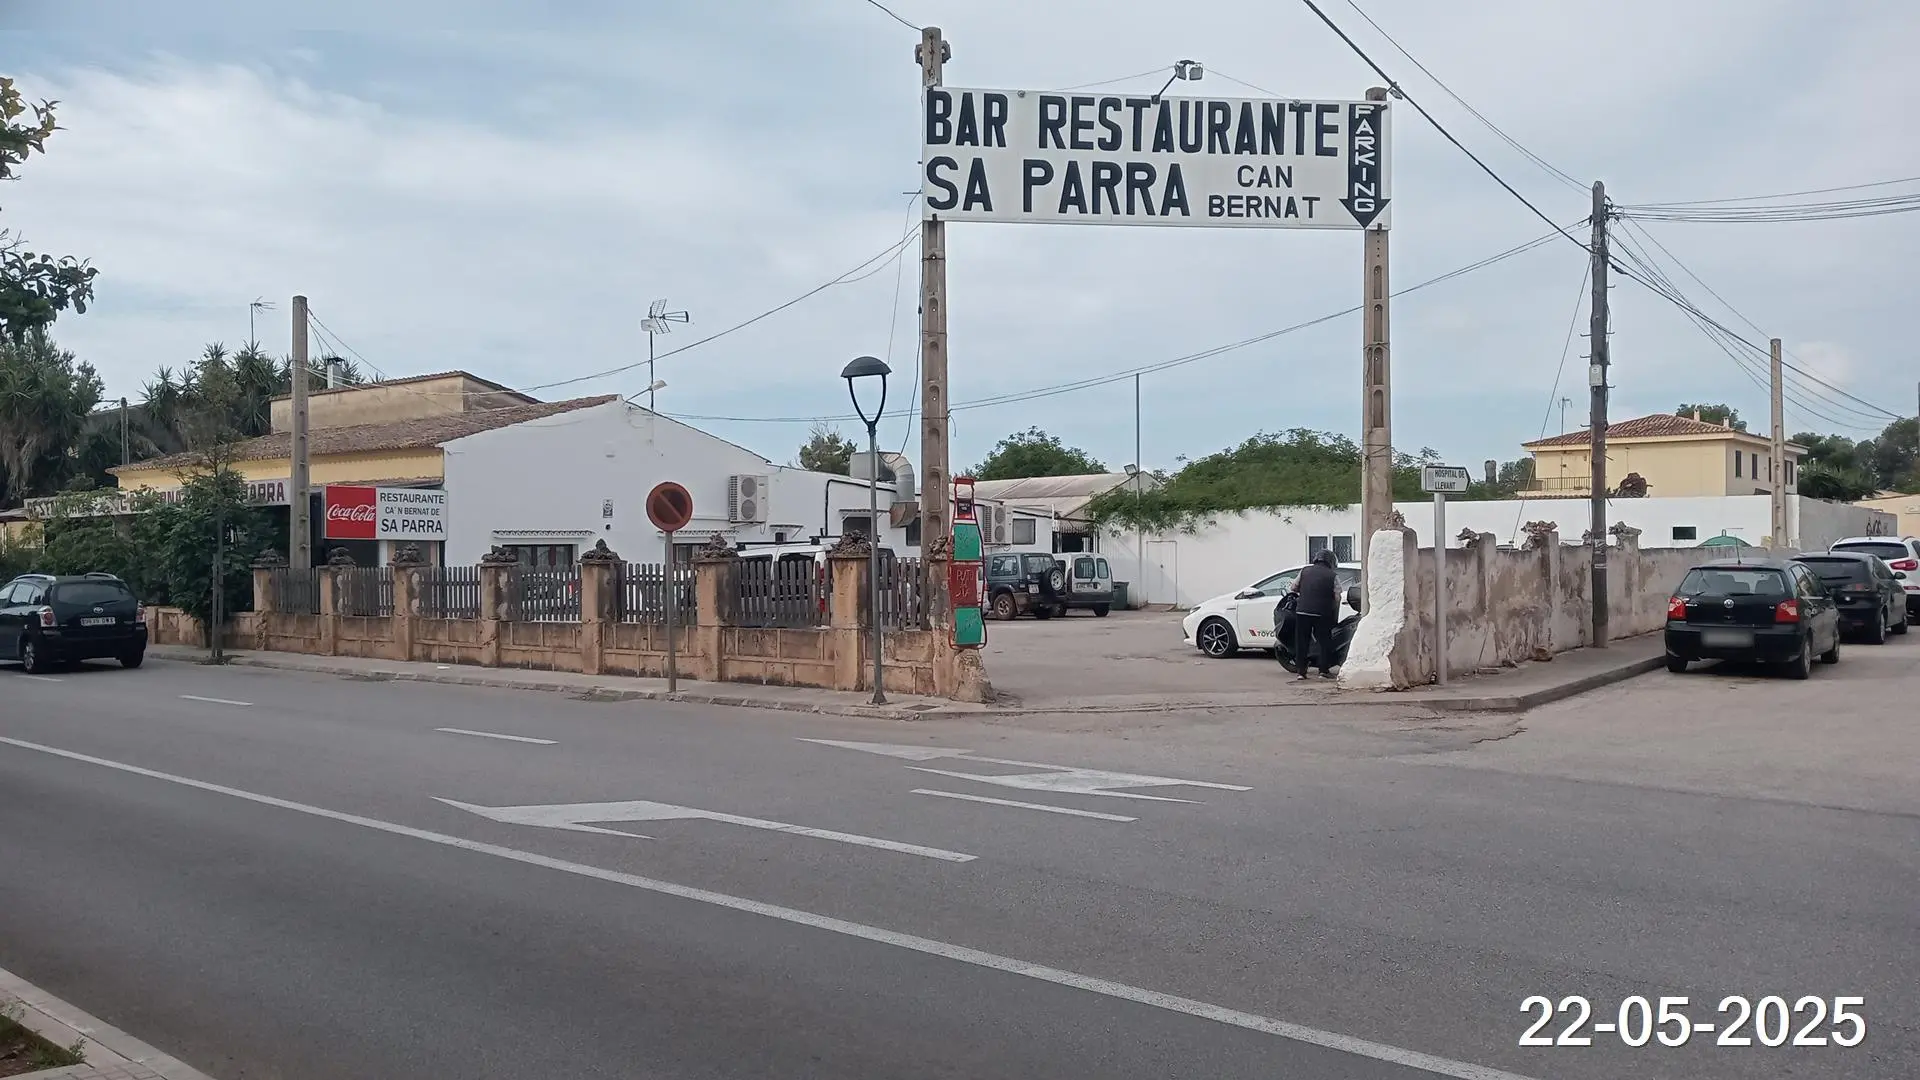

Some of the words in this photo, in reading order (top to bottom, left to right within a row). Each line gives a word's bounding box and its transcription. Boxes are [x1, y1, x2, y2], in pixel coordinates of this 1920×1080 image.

[926, 90, 1008, 148] BAR
[1038, 95, 1340, 157] RESTAURANTE
[1237, 165, 1293, 188] CAN
[926, 156, 994, 212] SA
[1022, 160, 1191, 217] PARRA
[1208, 195, 1320, 219] BERNAT
[1434, 470, 1457, 478] HOSPITAL
[1458, 470, 1465, 478] DE
[1434, 481, 1456, 490] LLEVANT
[380, 492, 444, 504] RESTAURANTE
[404, 507, 429, 516] BERNAT
[431, 508, 440, 516] DE
[381, 518, 398, 532] SA
[402, 519, 443, 533] PARRA
